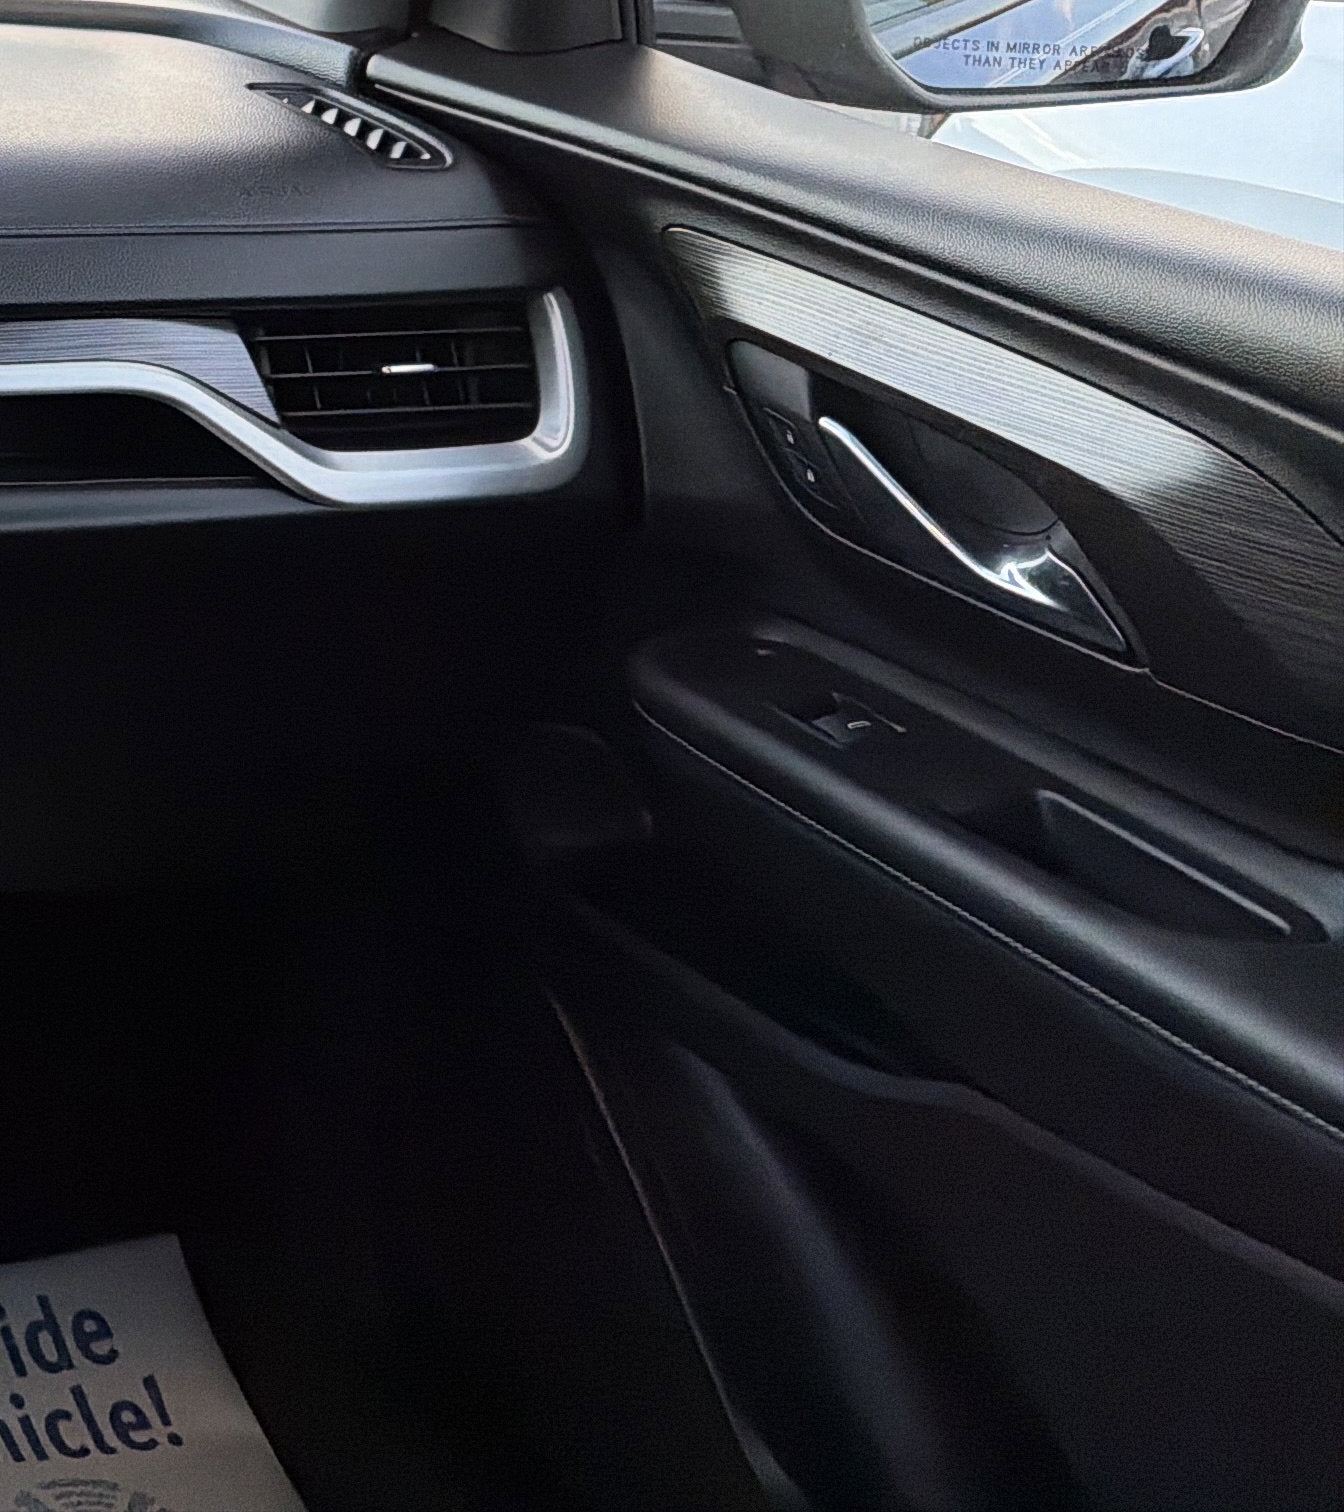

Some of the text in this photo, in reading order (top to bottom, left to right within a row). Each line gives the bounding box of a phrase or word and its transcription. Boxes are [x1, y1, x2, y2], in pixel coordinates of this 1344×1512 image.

[986, 40, 1001, 52] IN
[1006, 41, 1061, 56] MIRROR
[963, 54, 1002, 68] THAN
[1008, 57, 1047, 70] THEY
